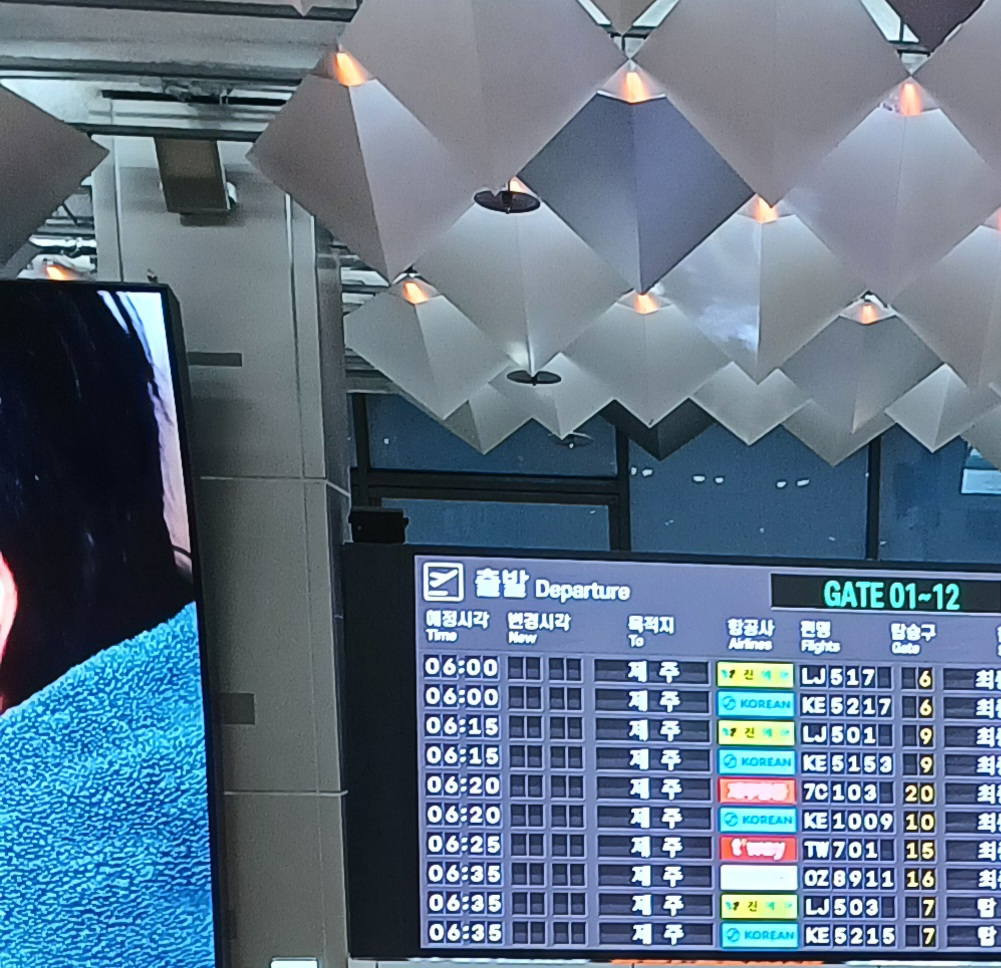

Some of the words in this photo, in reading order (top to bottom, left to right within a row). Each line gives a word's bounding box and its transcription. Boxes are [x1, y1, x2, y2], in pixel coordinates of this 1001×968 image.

[475, 568, 530, 598] 출발
[535, 579, 631, 603] Departure
[823, 580, 885, 609] GATE
[889, 581, 960, 611] 01~12
[425, 657, 498, 677] 06:00
[802, 667, 875, 686] LJ517
[919, 670, 931, 688] 6
[425, 687, 499, 706] 06:00
[740, 698, 791, 709] KOREAN
[802, 696, 891, 715] KE5217
[919, 699, 932, 716] 6
[426, 716, 499, 736] 06:15
[803, 725, 876, 744] LJ501
[920, 727, 932, 745] 9
[426, 746, 499, 765] 06:15
[741, 756, 792, 767] KOREAN
[803, 754, 892, 773] KE5153
[920, 756, 933, 773] 9
[427, 776, 500, 794] 06:20
[803, 783, 877, 801] 7C103
[905, 785, 933, 802] 20
[427, 805, 501, 824] 06:20
[742, 814, 793, 826] KOREAN
[804, 812, 893, 830] KE1009
[906, 813, 934, 831] 10
[428, 835, 501, 853] 06:25
[804, 841, 878, 858] TW701
[906, 842, 934, 860] 15
[428, 864, 501, 883] 06:35
[907, 870, 934, 888] 16
[429, 894, 502, 912] 06:35
[805, 898, 879, 916] LJ503
[923, 899, 935, 916] 7
[429, 923, 502, 942] 06:35
[744, 929, 795, 940] KOREAN
[805, 926, 895, 945] KE5215
[923, 927, 935, 945] 7
